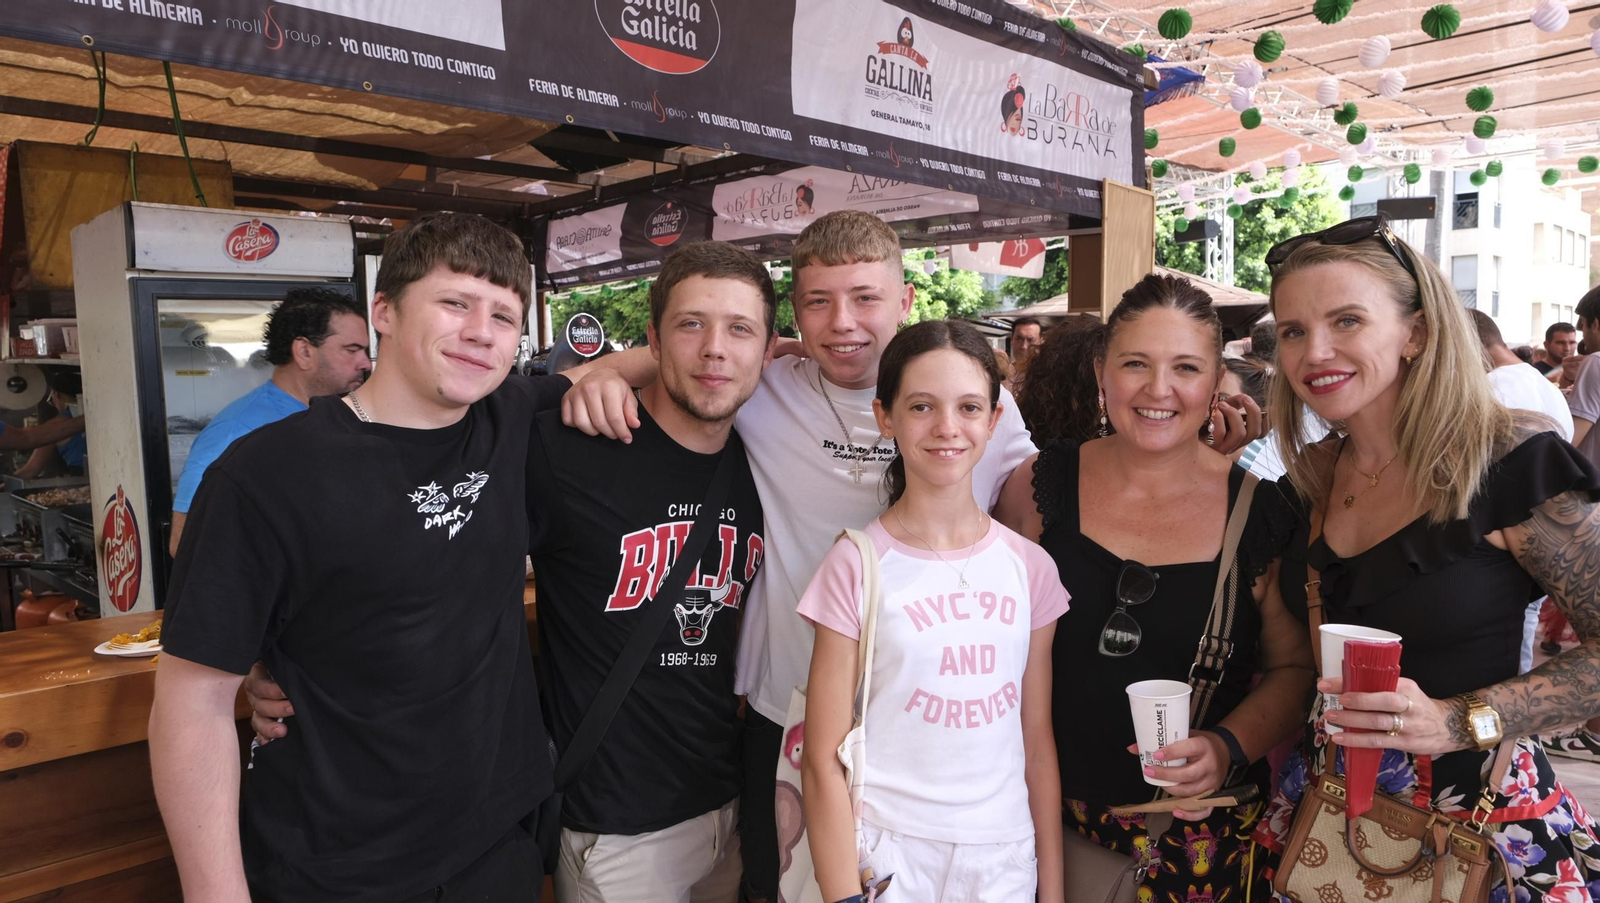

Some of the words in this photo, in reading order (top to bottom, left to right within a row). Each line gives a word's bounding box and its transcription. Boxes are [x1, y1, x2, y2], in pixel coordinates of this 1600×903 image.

[957, 2, 972, 16] TODO
[130, 0, 204, 26] ALMERIA
[339, 36, 359, 55] YO
[362, 41, 409, 64] QUIERO
[411, 51, 444, 71] TODO
[446, 58, 497, 81] CONTIGO
[621, 5, 698, 51] Galicia
[889, 44, 908, 56] CANTA
[909, 50, 918, 62] LA
[865, 54, 933, 102] GALLINA
[528, 78, 560, 97] FERIA
[560, 84, 575, 99] DE
[576, 87, 620, 108] ALMERIA
[697, 111, 710, 124] YO
[711, 113, 740, 130] QUIERO
[740, 120, 761, 135] TODO
[760, 125, 793, 141] CONTIGO
[870, 109, 898, 123] GENERAL
[1027, 118, 1117, 159] BURANA
[1101, 116, 1117, 136] de
[808, 134, 830, 149] FERIA
[830, 138, 841, 151] DE
[840, 141, 869, 157] ALMERIA
[919, 157, 930, 168] YO
[930, 159, 950, 173] QUIERO
[949, 163, 965, 175] TODO
[964, 165, 986, 180] CONTIGO
[997, 171, 1013, 182] FERIA
[1012, 174, 1020, 184] DE
[1076, 187, 1084, 196] YO
[243, 225, 260, 240] La
[228, 233, 273, 258] Casera
[571, 326, 599, 335] Estrella
[573, 334, 598, 343] Galicia
[822, 439, 838, 450] It's
[872, 446, 893, 454] Tote
[112, 505, 126, 548] La
[424, 504, 466, 530] DARK
[103, 534, 137, 597] Casera
[902, 591, 971, 633] NYC
[659, 652, 718, 667] 1968-1969
[938, 643, 996, 676] AND
[904, 681, 1019, 729] FOREVER
[1385, 807, 1412, 822] GUESS
